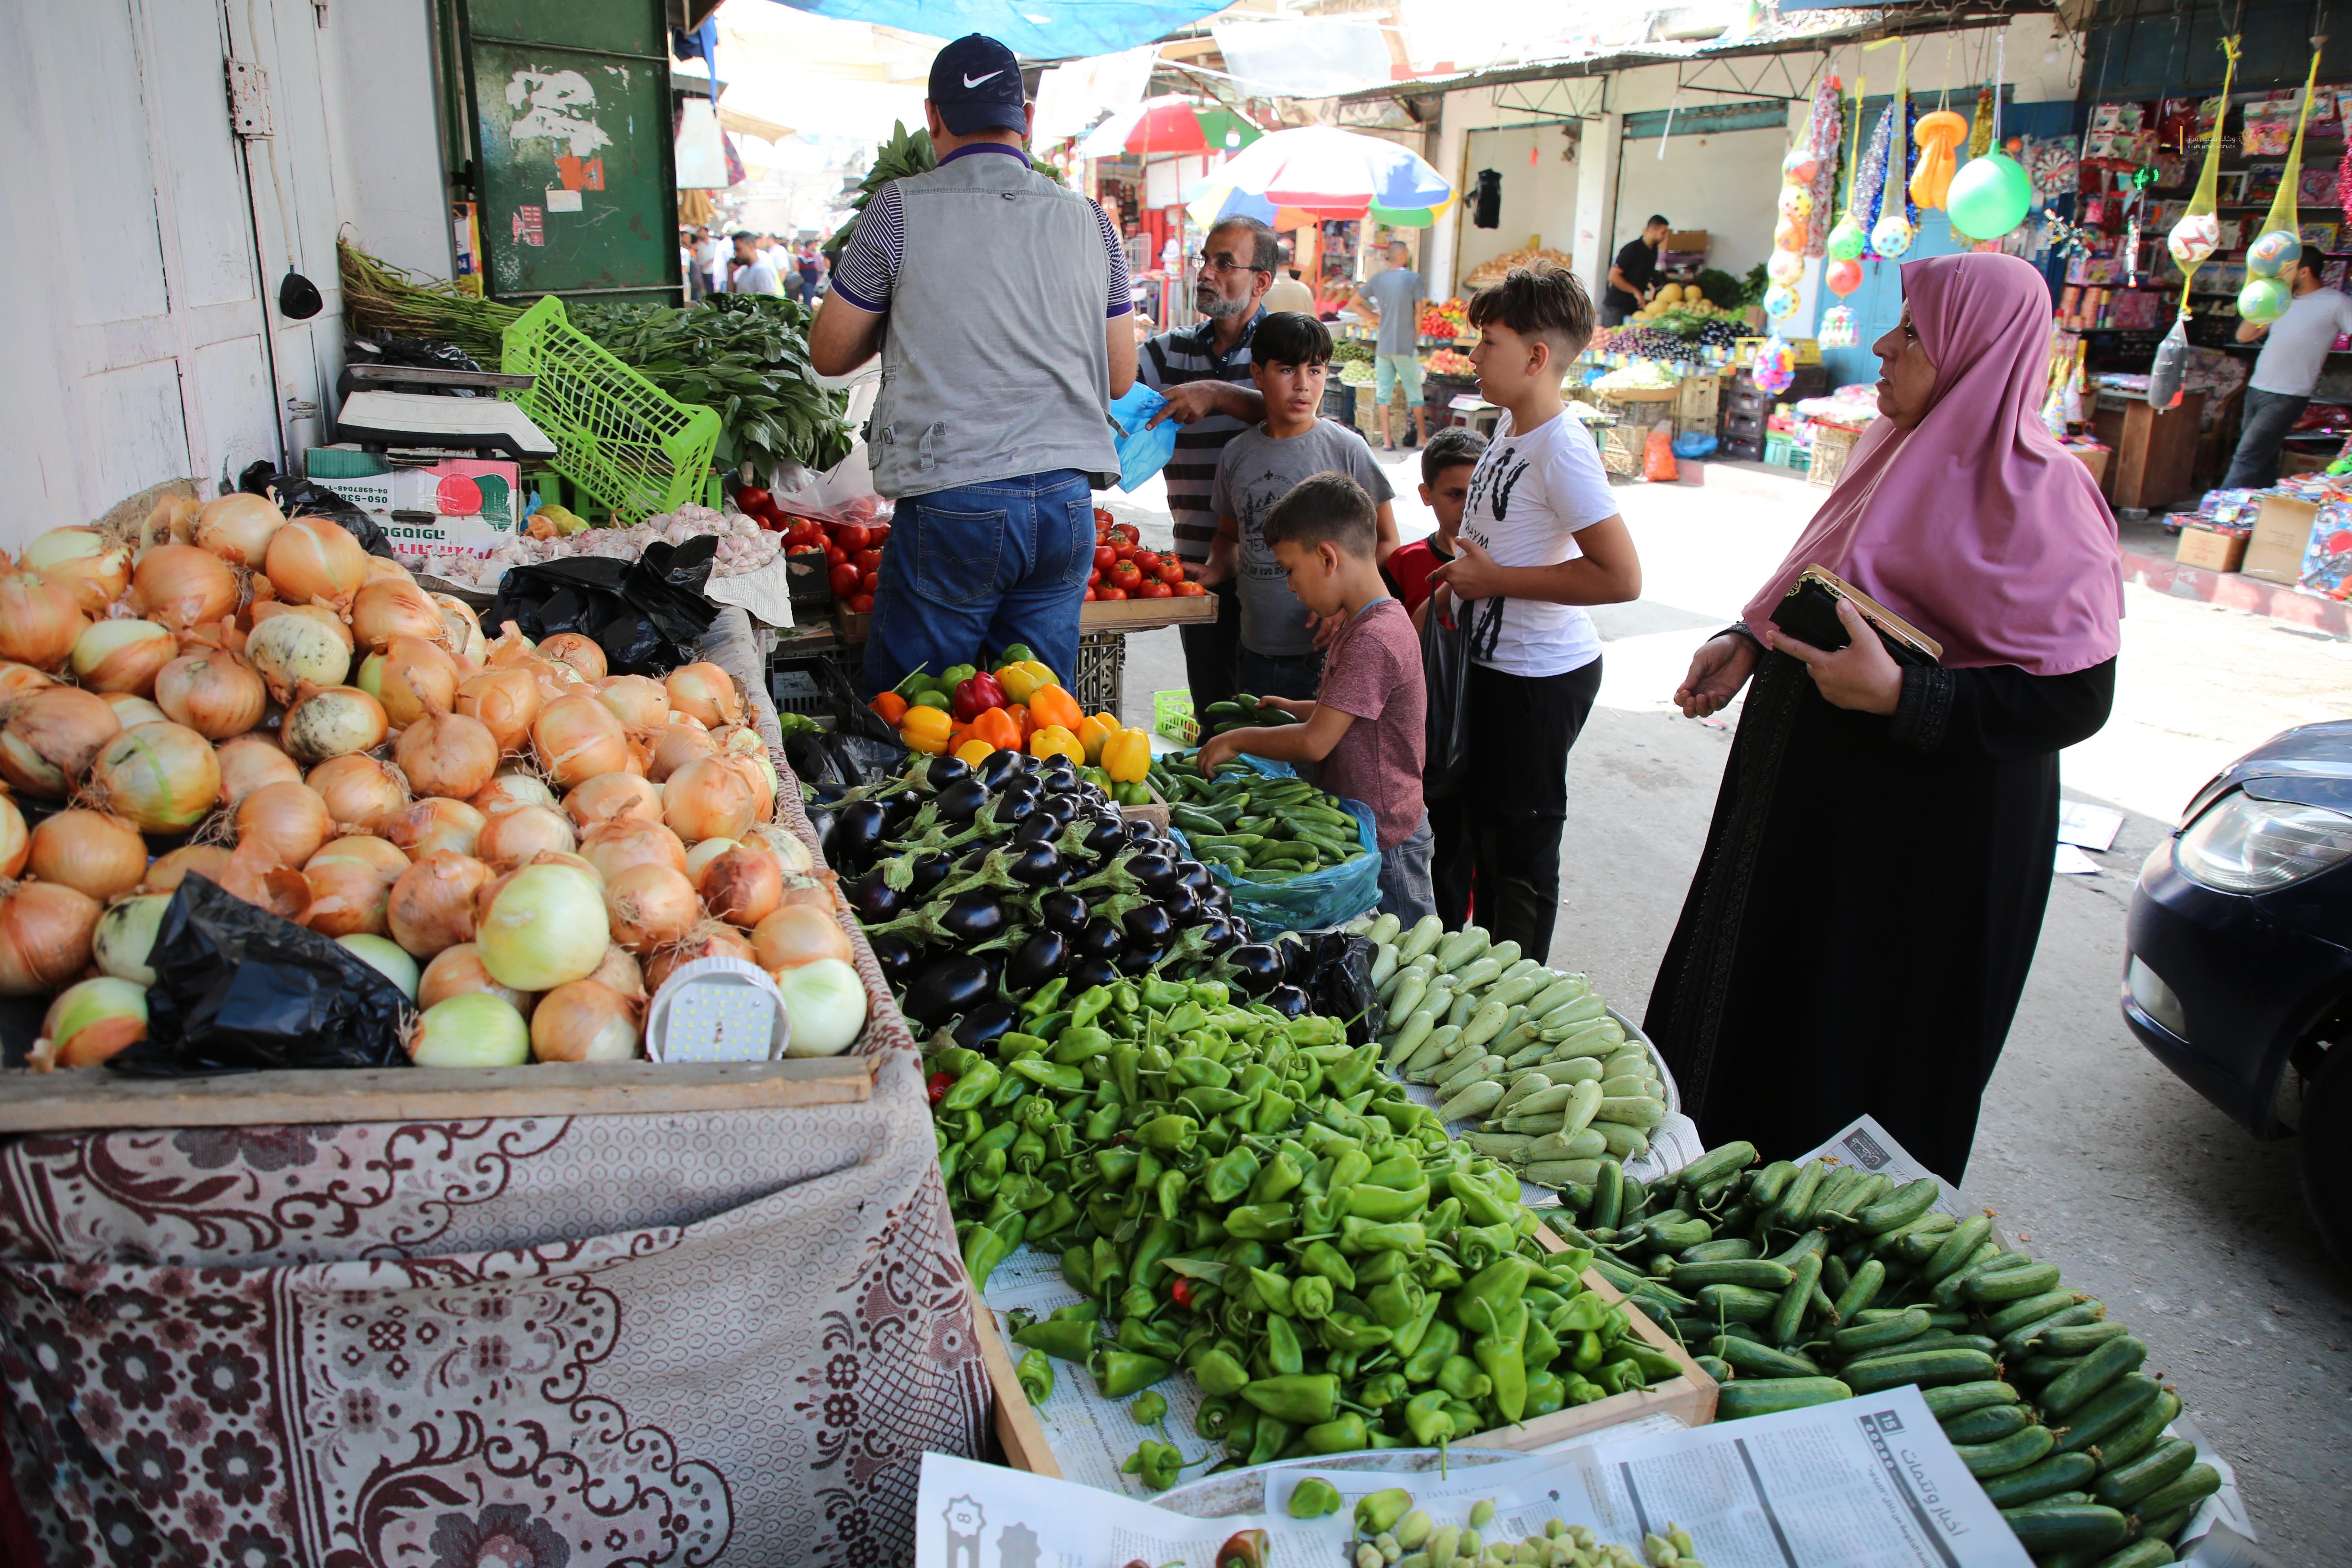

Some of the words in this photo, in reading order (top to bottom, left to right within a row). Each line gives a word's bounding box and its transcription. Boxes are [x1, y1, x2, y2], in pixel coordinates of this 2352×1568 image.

[1881, 1415, 1897, 1430] 15
[1901, 1450, 1940, 1504] وتتمات
[1930, 1507, 1970, 1537] أخبار
